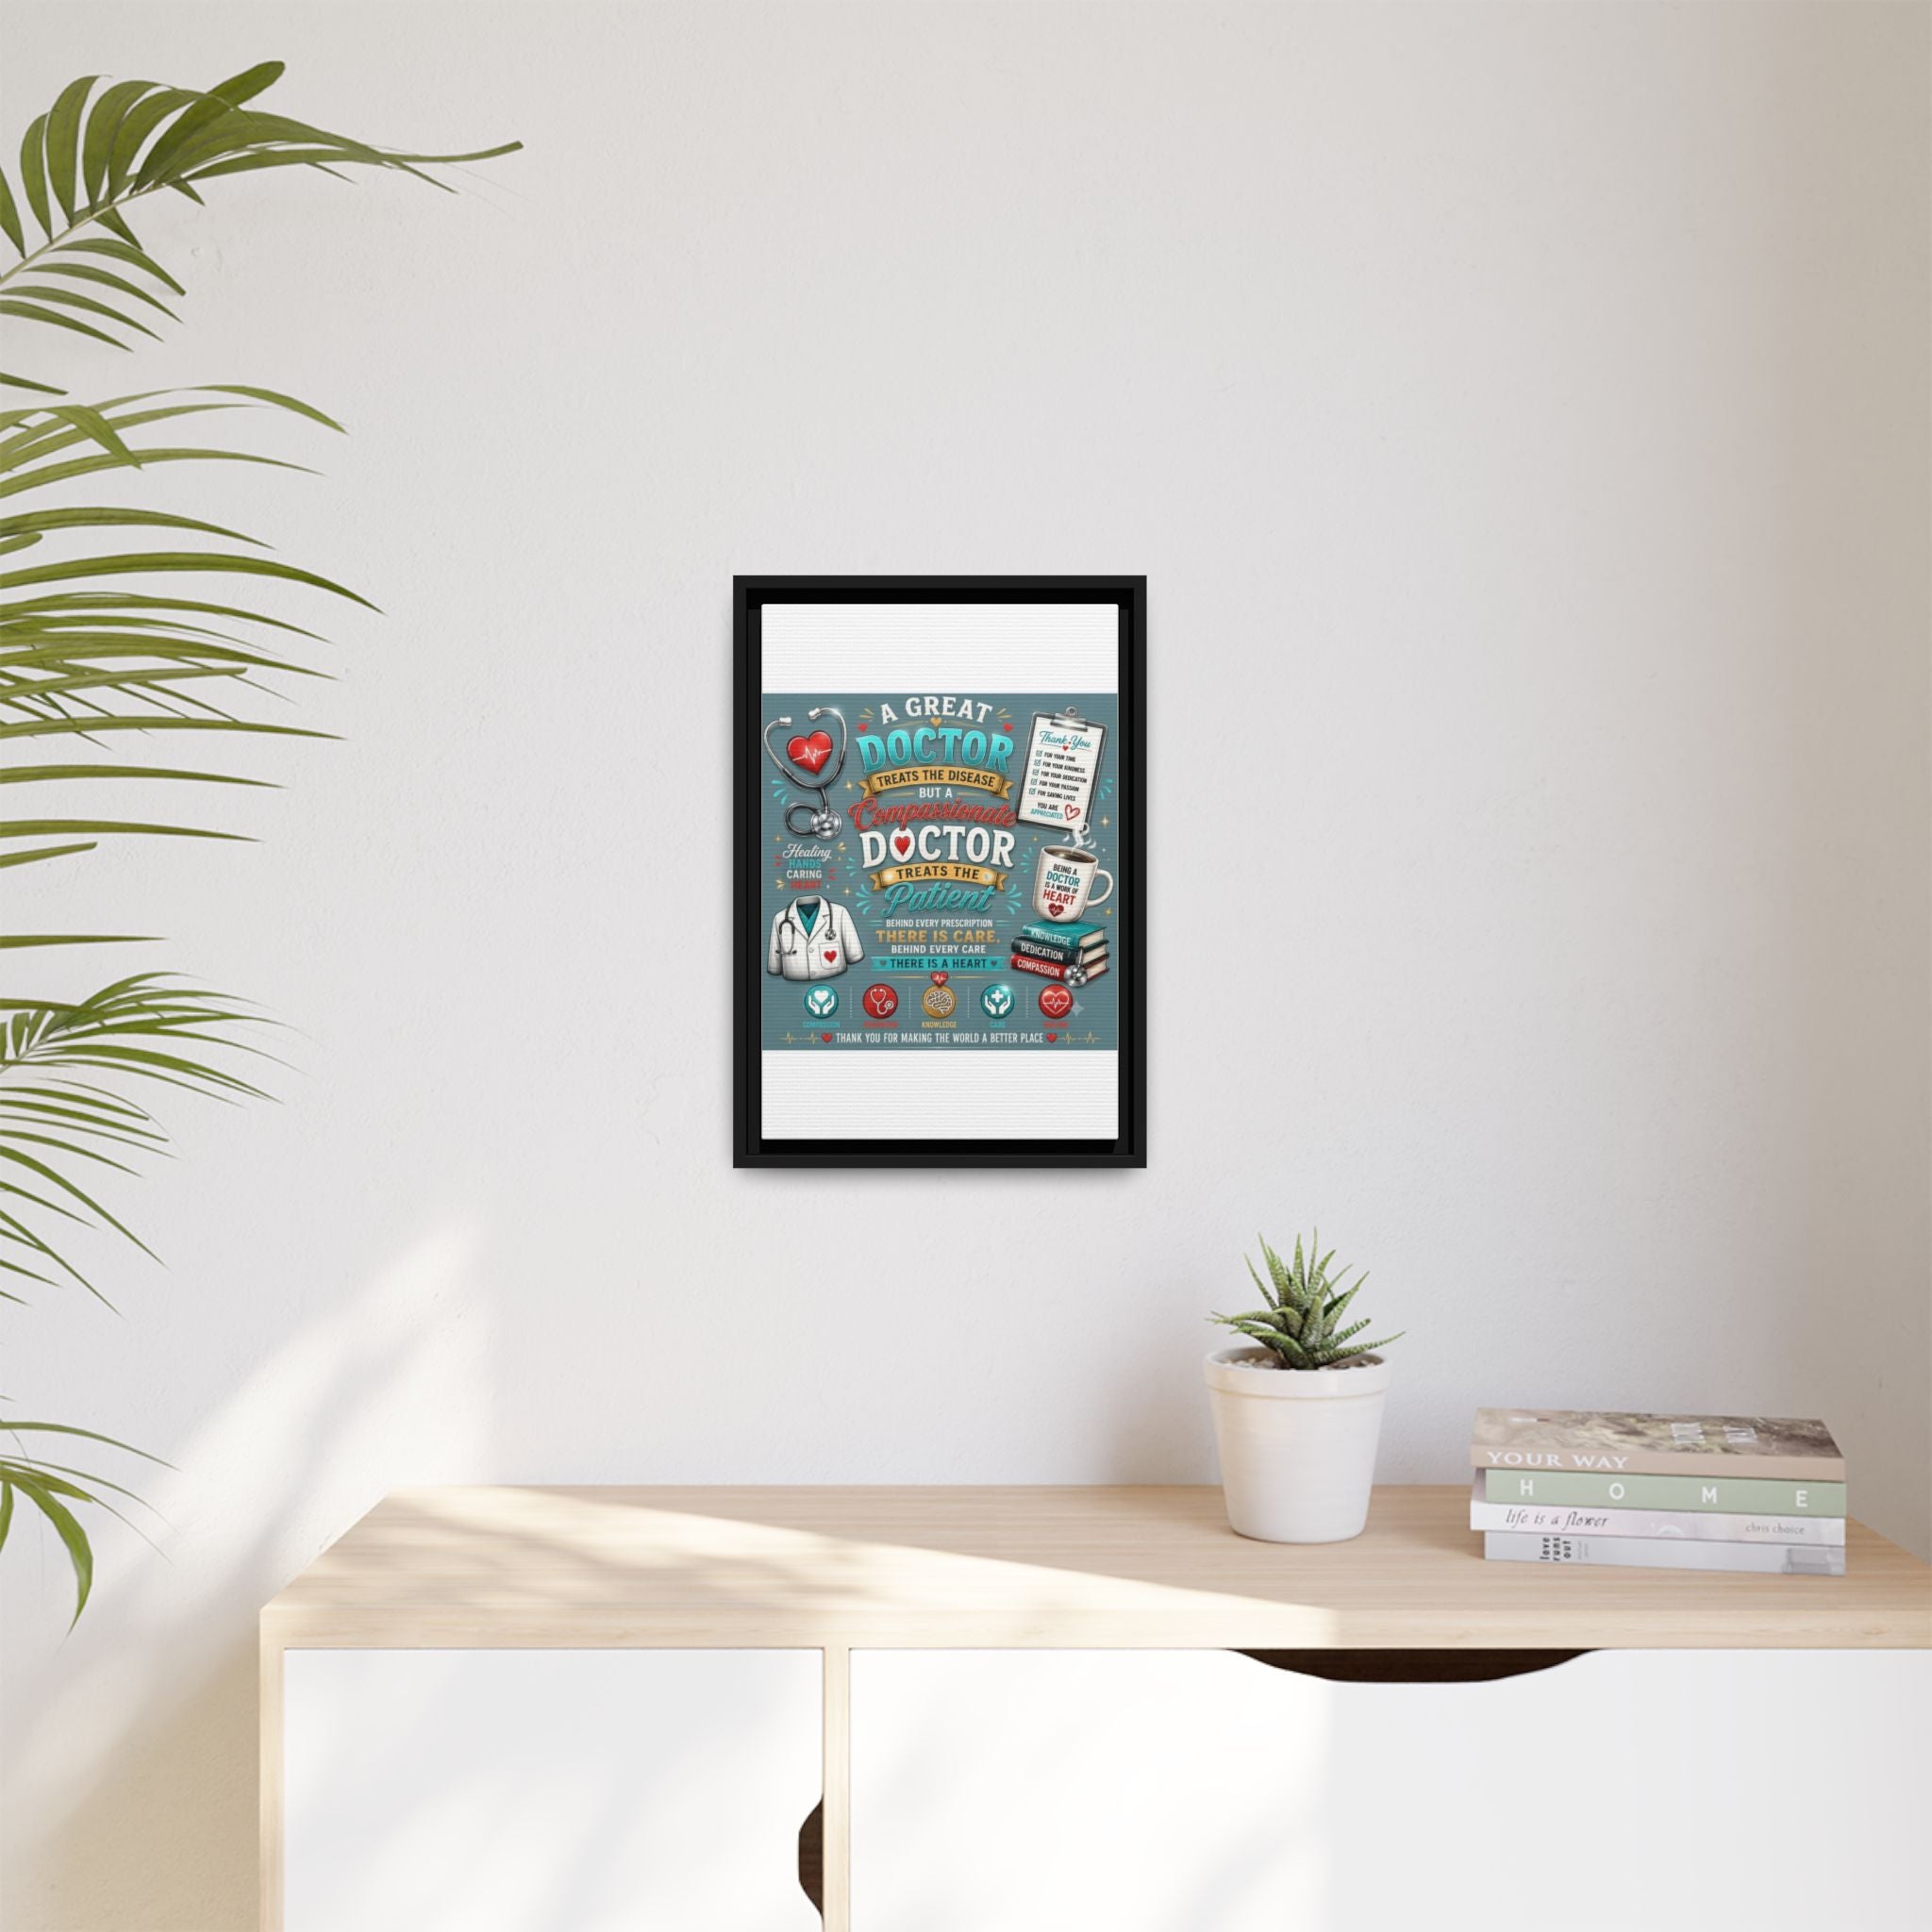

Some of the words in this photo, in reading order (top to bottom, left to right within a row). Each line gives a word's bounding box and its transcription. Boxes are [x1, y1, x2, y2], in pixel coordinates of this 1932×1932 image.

[880, 703, 898, 724] A
[905, 696, 993, 724] GREAT
[1039, 730, 1068, 744] Thank
[1070, 735, 1092, 750] You
[855, 726, 1014, 774] DOCTOR
[876, 771, 919, 788] TREATS
[923, 770, 944, 781] THE
[948, 770, 996, 788] DISEASE
[1060, 783, 1080, 792] PASSION
[919, 787, 941, 798] BUT
[945, 787, 953, 798] A
[1046, 791, 1063, 800] SAVING
[1063, 793, 1076, 802] LIVES
[847, 797, 1018, 831] Compassionate
[782, 843, 832, 862] Healing
[859, 824, 1015, 869] DOCTOR
[789, 858, 822, 869] HANDS
[1053, 863, 1072, 874] BEING
[786, 870, 823, 879] CARING
[896, 866, 948, 879] TREATS
[954, 866, 980, 879] THE
[1046, 872, 1080, 887] DOCTOR
[1057, 884, 1071, 893] WORK
[881, 881, 995, 918] Patient
[1042, 890, 1076, 906] HEART
[886, 919, 914, 927] BEHIND
[915, 919, 940, 927] EVERY
[941, 919, 993, 927] PRESCRIPTION
[875, 929, 927, 943] THERE
[933, 929, 948, 943] IS
[953, 929, 1001, 943] CARE.
[1031, 929, 1071, 946] KNOWLEDGE
[891, 944, 926, 954] BEHIND
[929, 944, 959, 954] EVERY
[961, 944, 987, 954] CARE
[1021, 942, 1064, 960] DEDICATION
[891, 958, 924, 969] THERE
[927, 958, 938, 969] IS
[941, 958, 949, 969] A
[953, 958, 988, 969] HEART
[1017, 958, 1060, 977] COMPASSION
[836, 1033, 862, 1043] THANK
[865, 1033, 880, 1043] YOU
[882, 1033, 898, 1043] FOR
[901, 1033, 932, 1043] MAKING
[935, 1033, 950, 1043] THE
[952, 1033, 979, 1043] WORLD
[982, 1033, 988, 1043] A
[991, 1033, 1018, 1043] BETTER
[1021, 1033, 1043, 1043] PLACE
[1487, 1451, 1563, 1467] YOUR
[1573, 1455, 1630, 1469] WAY
[1520, 1478, 1808, 1508] HOME
[1506, 1508, 1528, 1529] life
[1534, 1512, 1546, 1525] is
[1551, 1515, 1559, 1525] a
[1561, 1510, 1609, 1532] flower
[1745, 1521, 1770, 1534] chris
[1773, 1523, 1806, 1536] choice
[1540, 1537, 1550, 1560] love
[1553, 1537, 1561, 1561] runs
[1562, 1541, 1572, 1559] out
